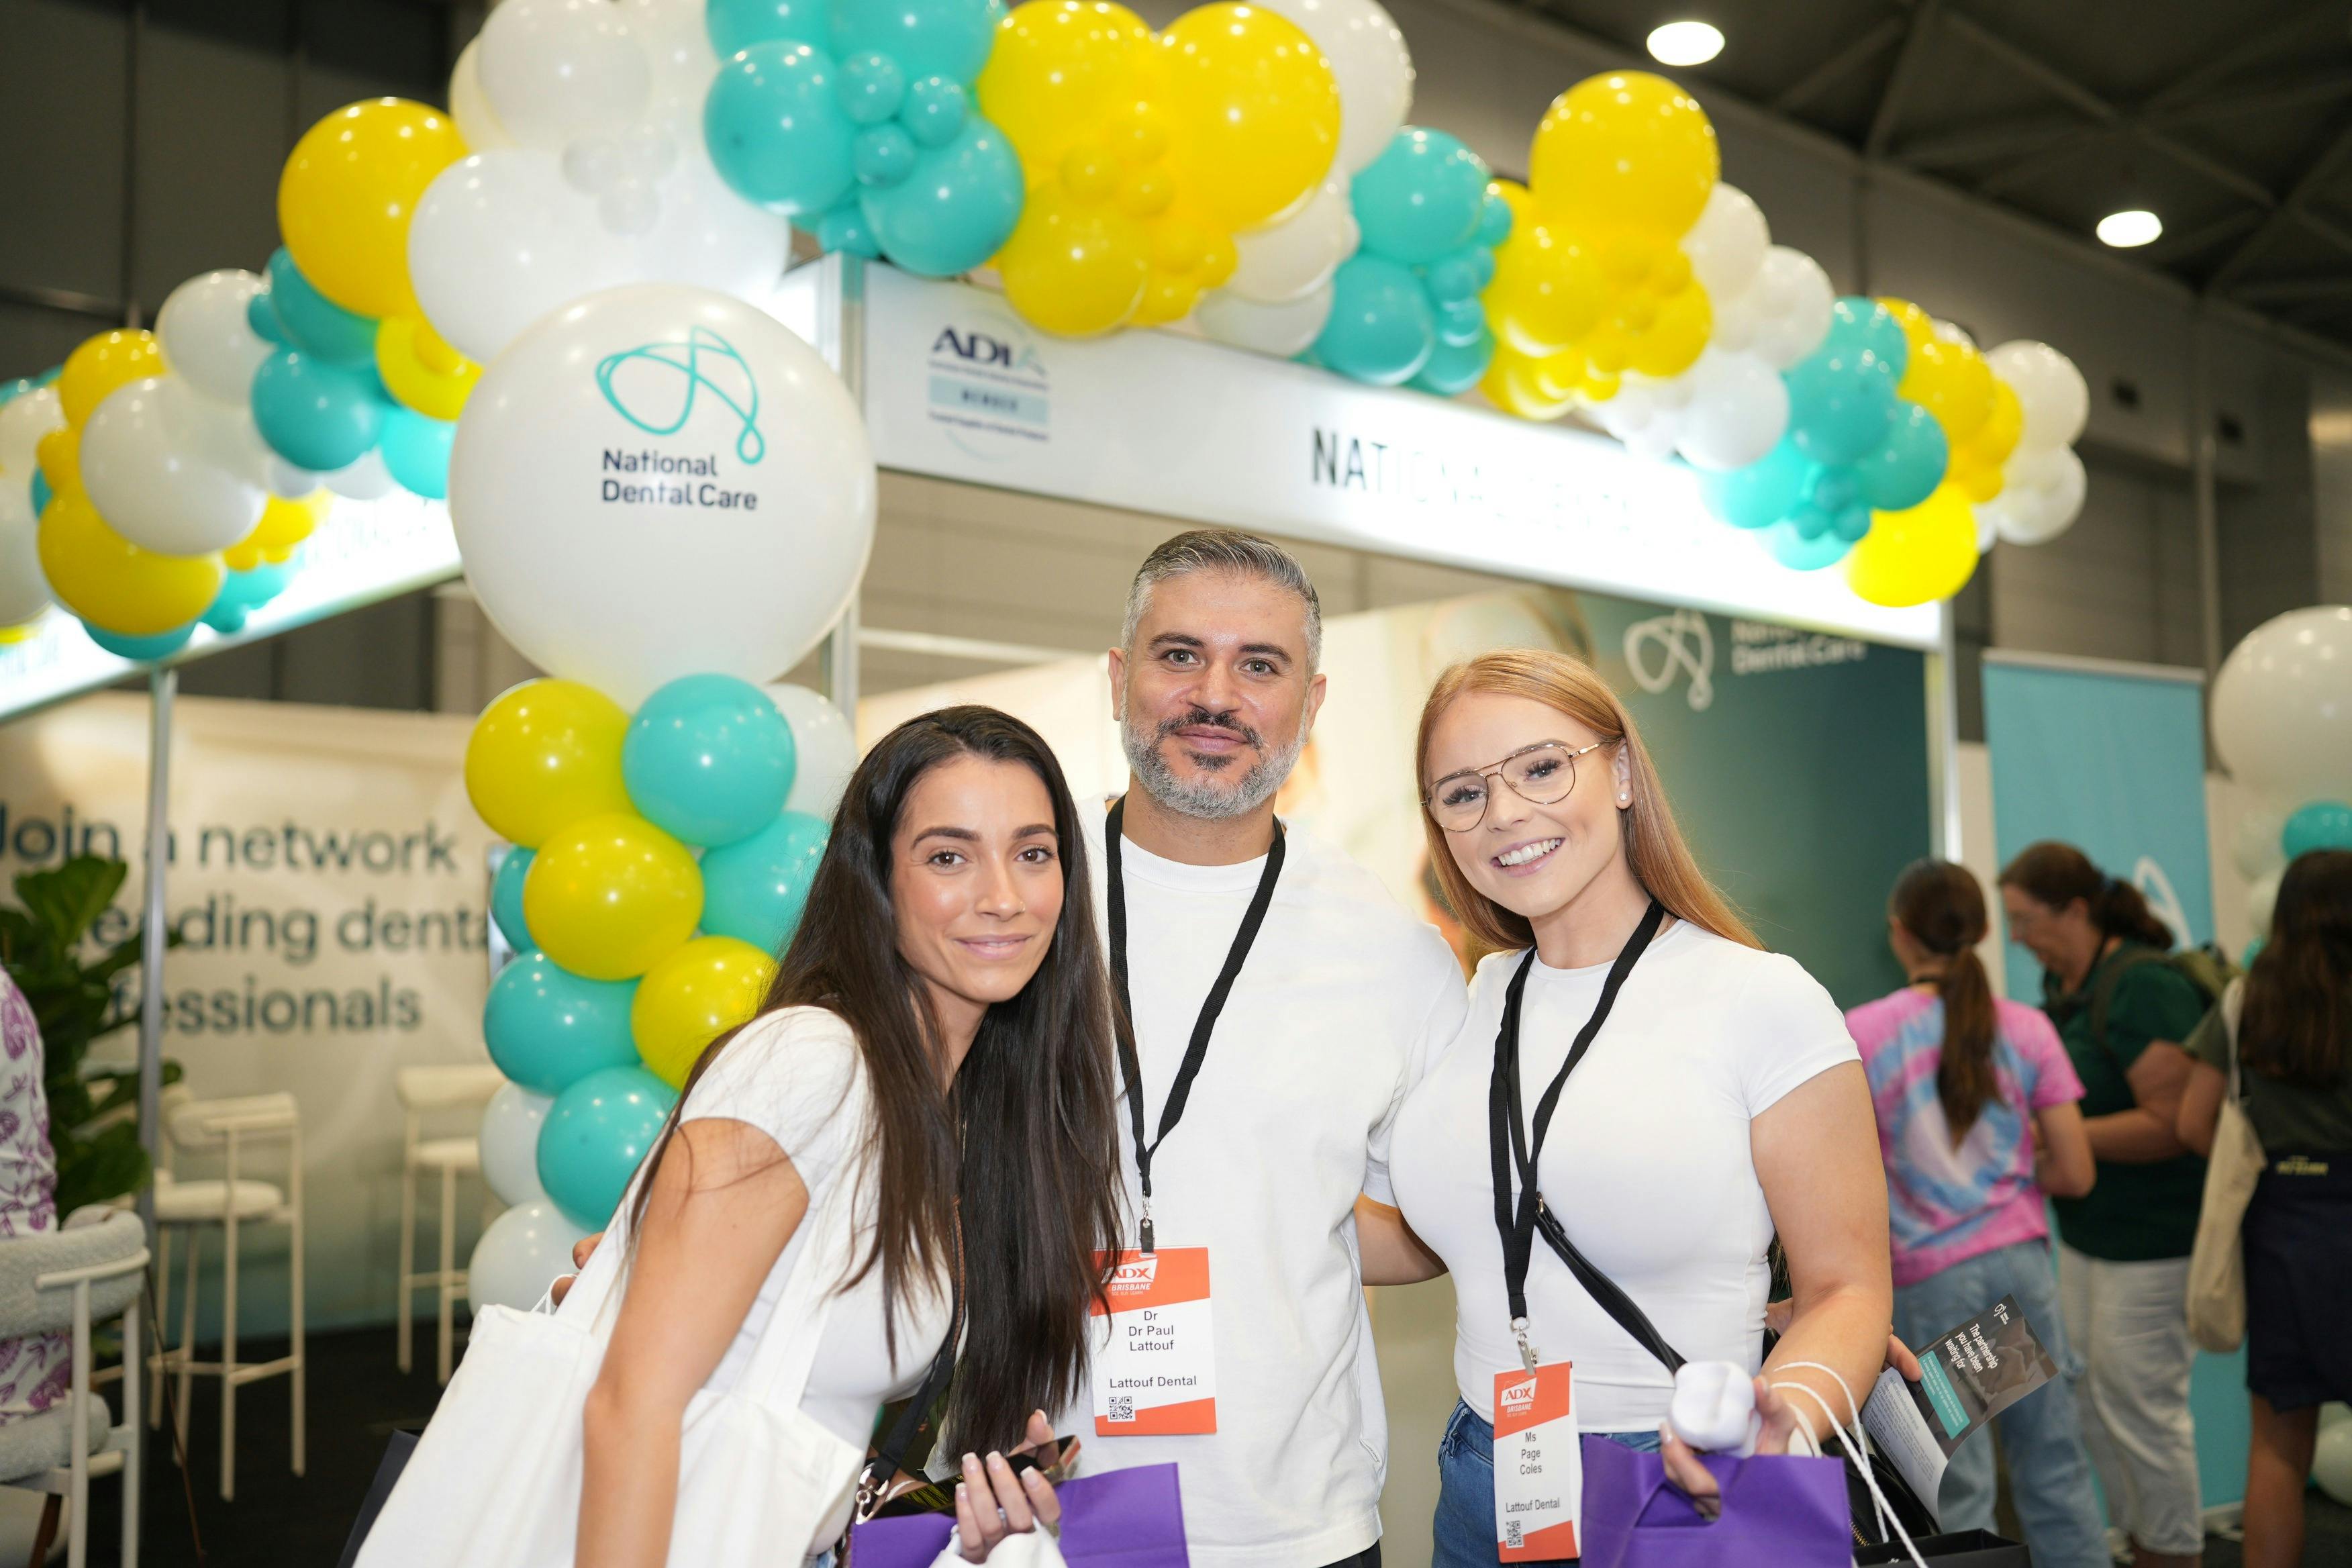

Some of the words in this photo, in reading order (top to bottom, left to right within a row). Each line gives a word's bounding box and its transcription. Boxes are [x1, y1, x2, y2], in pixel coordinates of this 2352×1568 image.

[603, 448, 718, 477] National
[602, 479, 693, 505] Dental
[699, 483, 758, 510] Care
[199, 817, 460, 873] network
[90, 893, 317, 964] eding
[336, 897, 489, 953] dent
[1112, 1283, 1151, 1291] BRISBANE
[1144, 1310, 1158, 1321] Dr
[1128, 1326, 1142, 1336] Dr
[1146, 1324, 1174, 1336] Paul
[1969, 1323, 1980, 1338] The
[1130, 1339, 1174, 1351] Lattouf
[1955, 1331, 1967, 1346] you
[1962, 1341, 1975, 1358] have
[1969, 1354, 1983, 1373] been
[1973, 1335, 1999, 1369] partnership
[1945, 1339, 1961, 1363] waiting
[1955, 1357, 1966, 1370] for
[1110, 1377, 1153, 1388] Lattouf
[1157, 1375, 1197, 1387] Dental
[1504, 1387, 1534, 1401] ADX
[1525, 1432, 1536, 1442] Ms
[1521, 1449, 1540, 1461] Page
[1520, 1463, 1542, 1475] Coles
[1506, 1500, 1533, 1513] Lattouf
[1535, 1498, 1561, 1510] Dental
